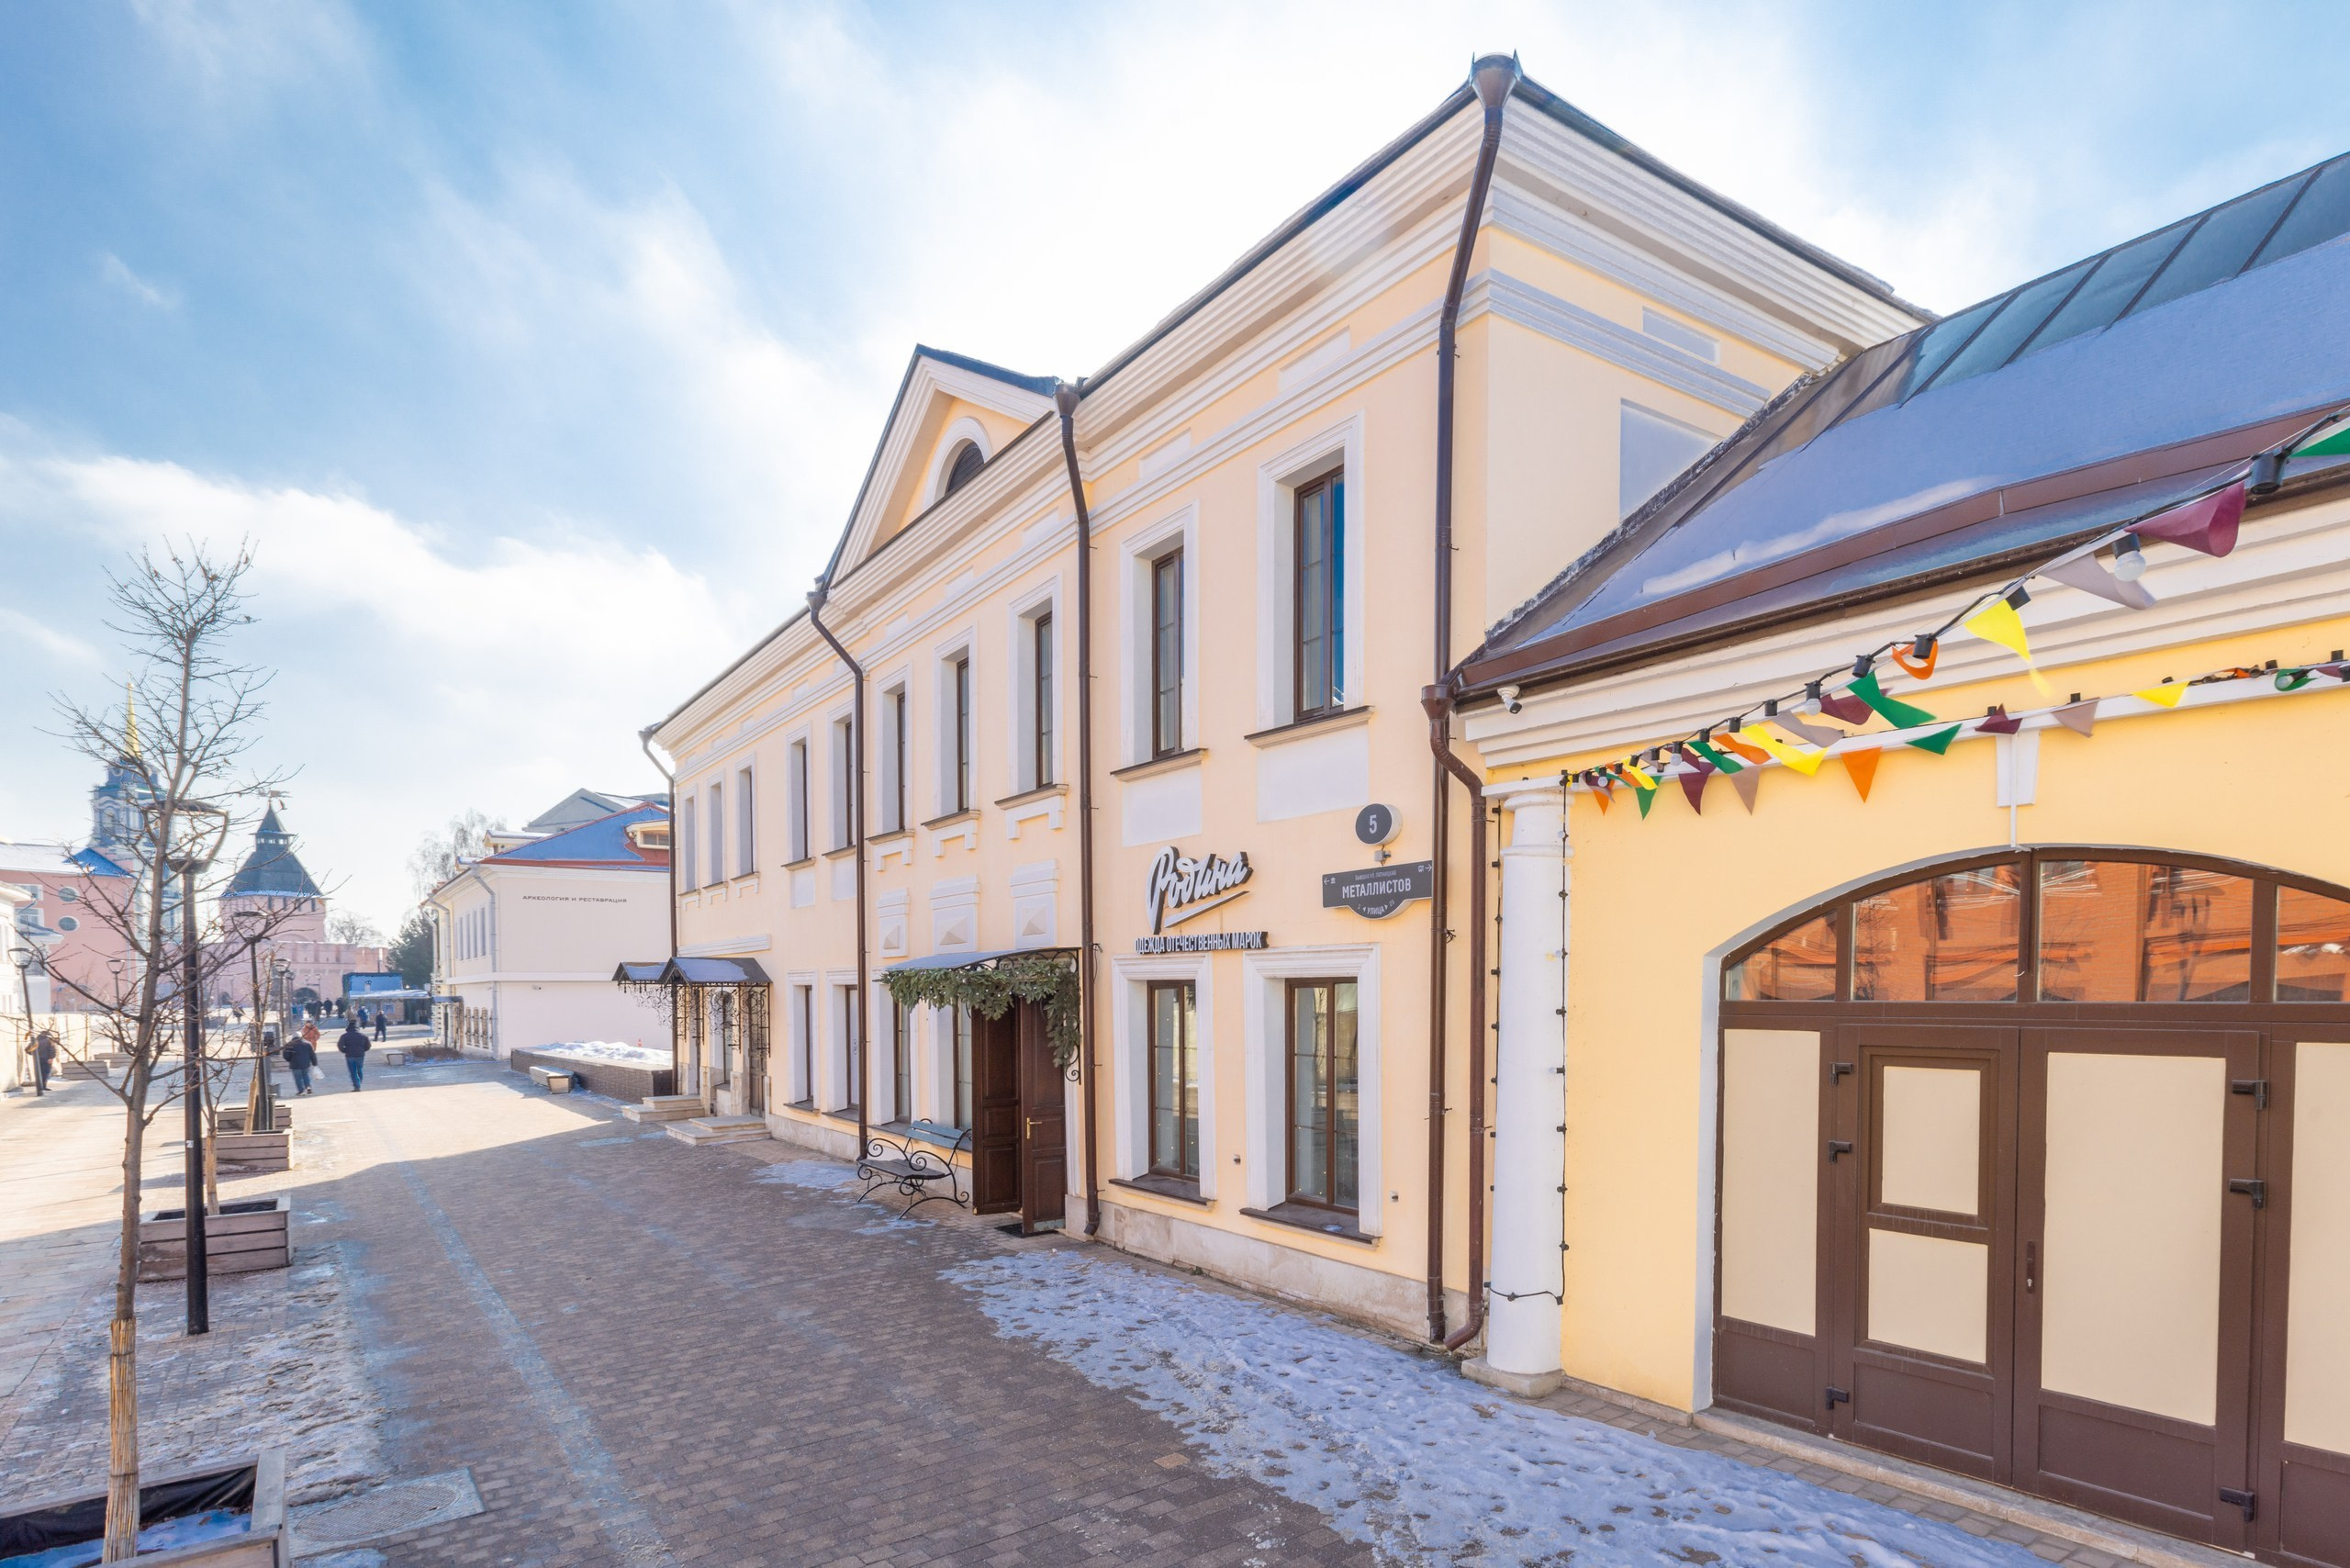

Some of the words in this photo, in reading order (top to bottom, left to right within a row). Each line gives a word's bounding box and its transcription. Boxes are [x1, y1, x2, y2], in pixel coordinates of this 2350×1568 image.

[1369, 814, 1378, 834] 5
[1146, 846, 1253, 935] Родина
[1342, 879, 1411, 899] МЕТАЛЛИСТОВ
[1367, 905, 1385, 915] УЛИЦА
[1135, 936, 1165, 954] ОДЕЖДА
[1166, 933, 1231, 952] ОТЕЧЕСТВЕННЫХ
[1231, 931, 1263, 949] МАРОК
